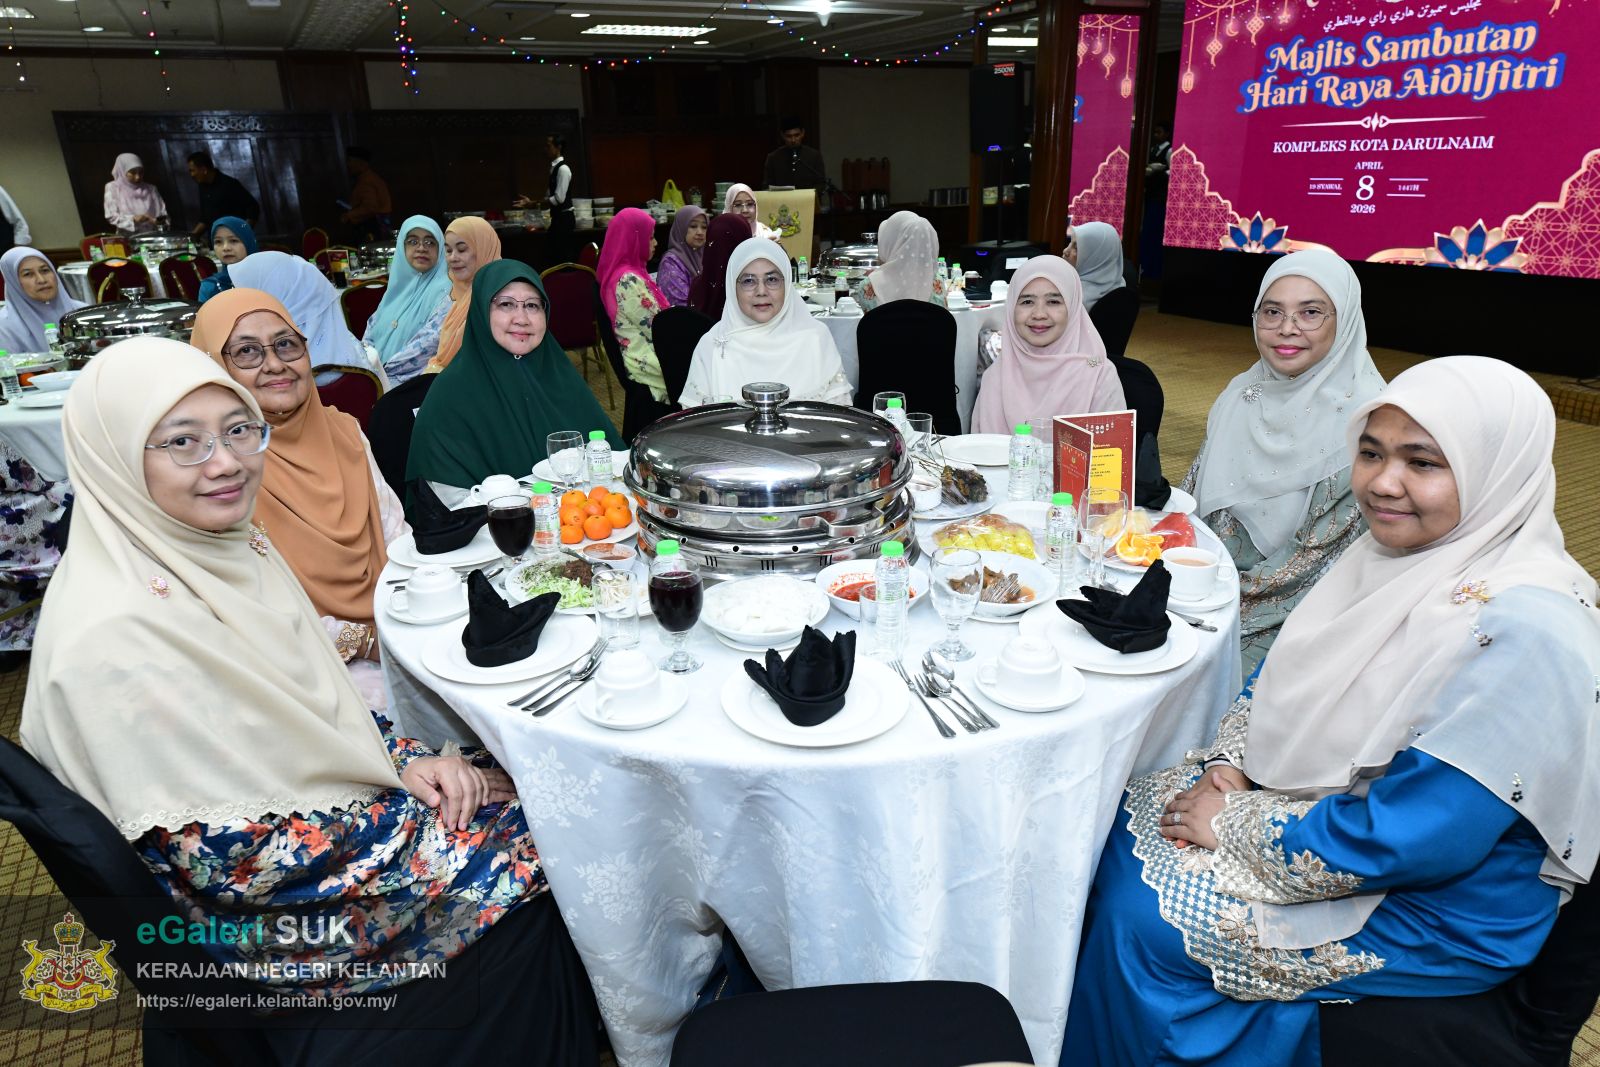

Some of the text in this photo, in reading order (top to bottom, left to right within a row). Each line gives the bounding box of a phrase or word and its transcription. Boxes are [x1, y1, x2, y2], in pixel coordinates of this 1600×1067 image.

[1369, 11, 1387, 26] راي
[1389, 6, 1414, 24] هاري
[1267, 24, 1537, 76] Majlis Sambutan
[993, 66, 1015, 75] 2500W
[1244, 57, 1559, 112] Hari Raya Aidilfitri
[1273, 136, 1495, 153] KOMPLEKS KOTA DARULNAIM
[1354, 161, 1384, 170] APRIL
[1356, 175, 1375, 201] 8
[1350, 204, 1376, 214] 2026
